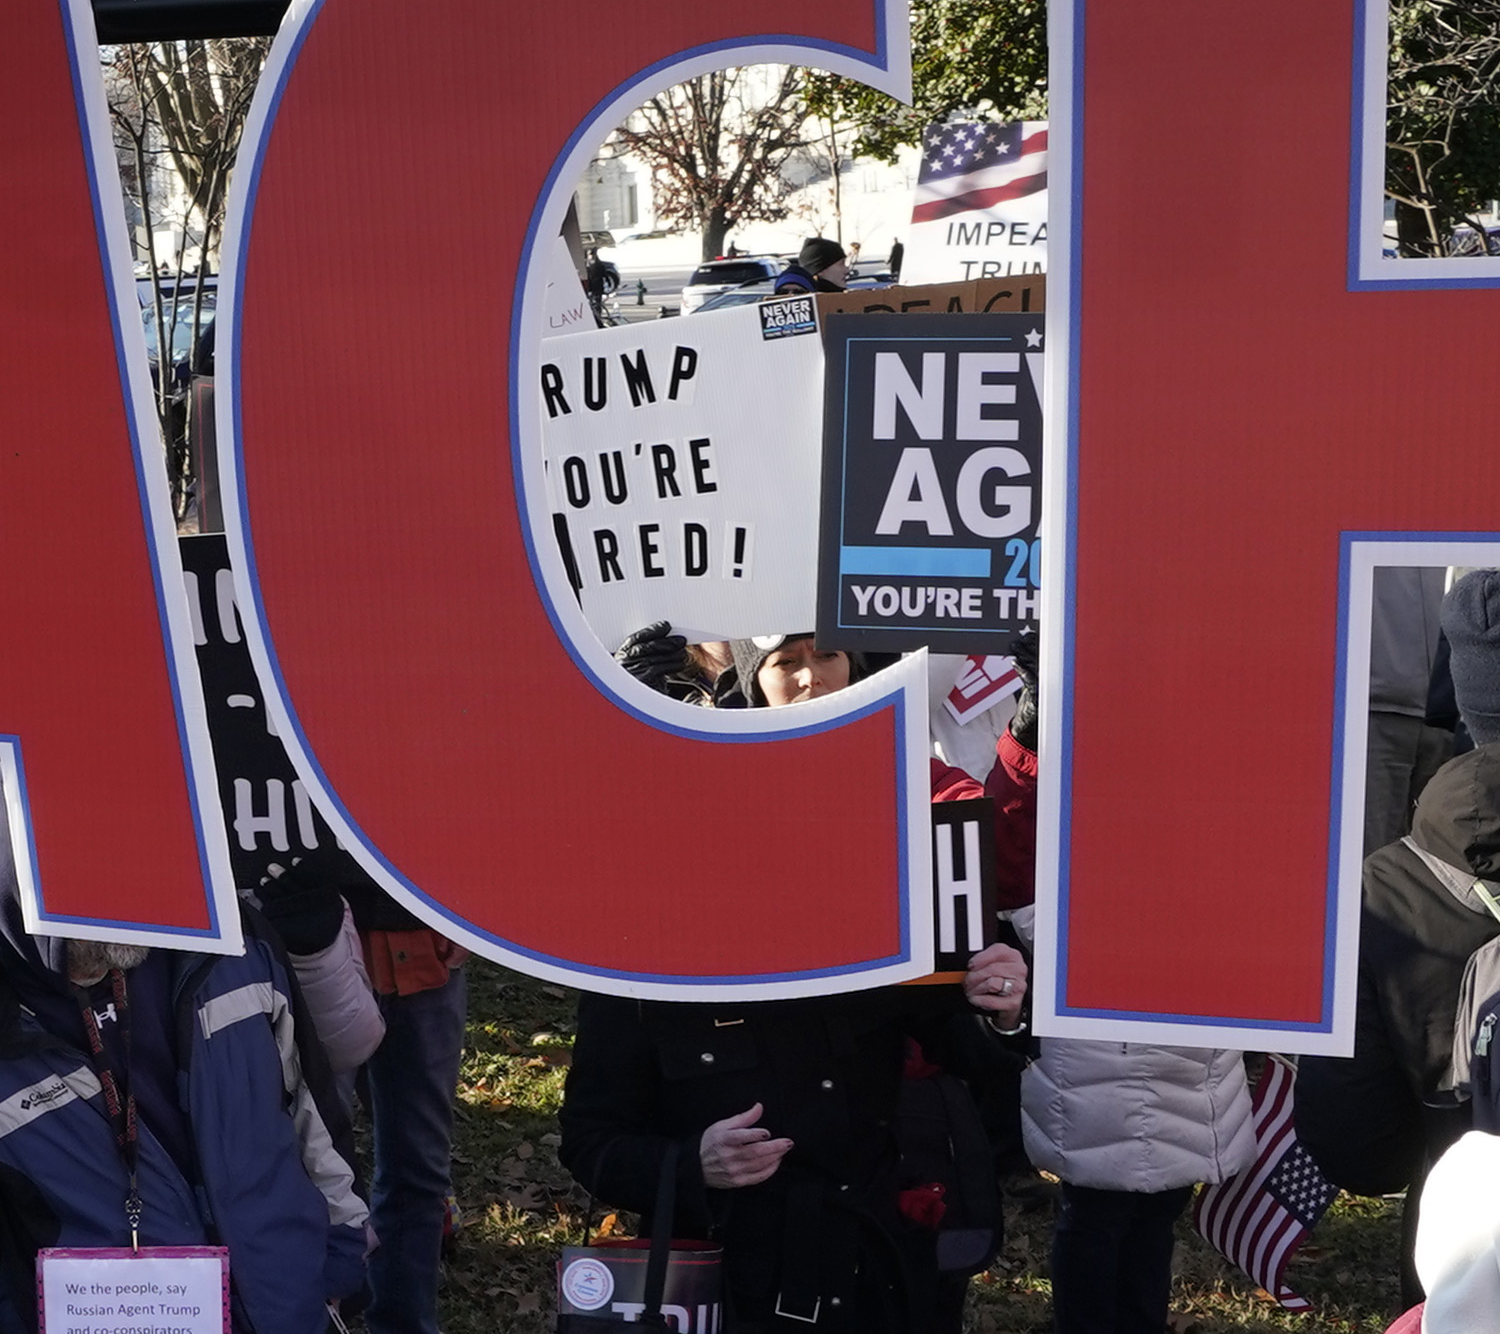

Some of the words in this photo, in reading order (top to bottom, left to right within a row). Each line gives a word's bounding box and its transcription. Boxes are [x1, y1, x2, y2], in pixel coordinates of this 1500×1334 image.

[946, 222, 1048, 246] IMPEA
[762, 300, 811, 317] NEVER
[766, 311, 810, 328] AGAIN
[541, 346, 698, 418] RUMP
[545, 438, 718, 509] OU'RE
[851, 585, 983, 619] YOU'RE
[993, 589, 1040, 619] TH
[65, 1283, 87, 1295] We
[91, 1283, 112, 1295] the
[115, 1282, 163, 1300] people,
[166, 1286, 187, 1300] say
[66, 1304, 114, 1316] Russian
[118, 1305, 155, 1320] Agent
[158, 1305, 201, 1321] Trump
